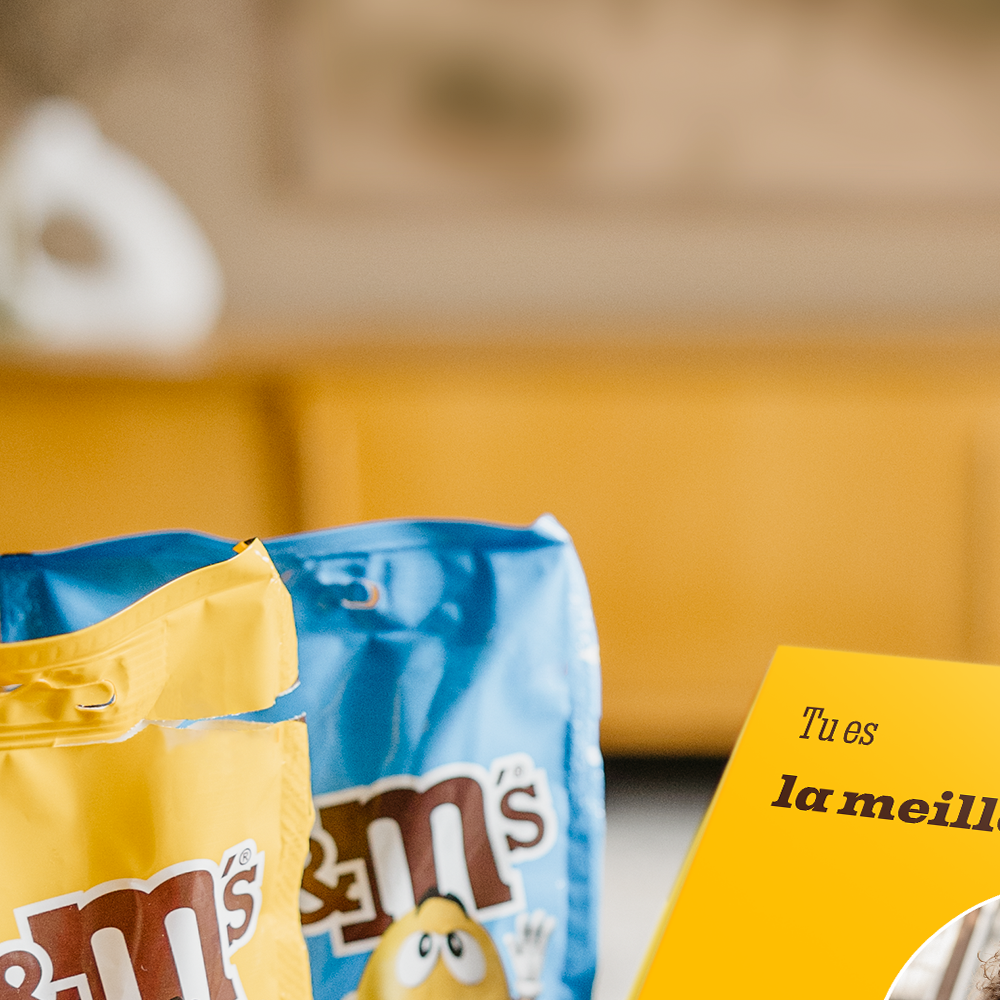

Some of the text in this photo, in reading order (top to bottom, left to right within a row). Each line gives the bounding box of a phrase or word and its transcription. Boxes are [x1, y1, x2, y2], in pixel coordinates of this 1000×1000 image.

[800, 706, 879, 745] Tu es
[771, 774, 834, 813] la
